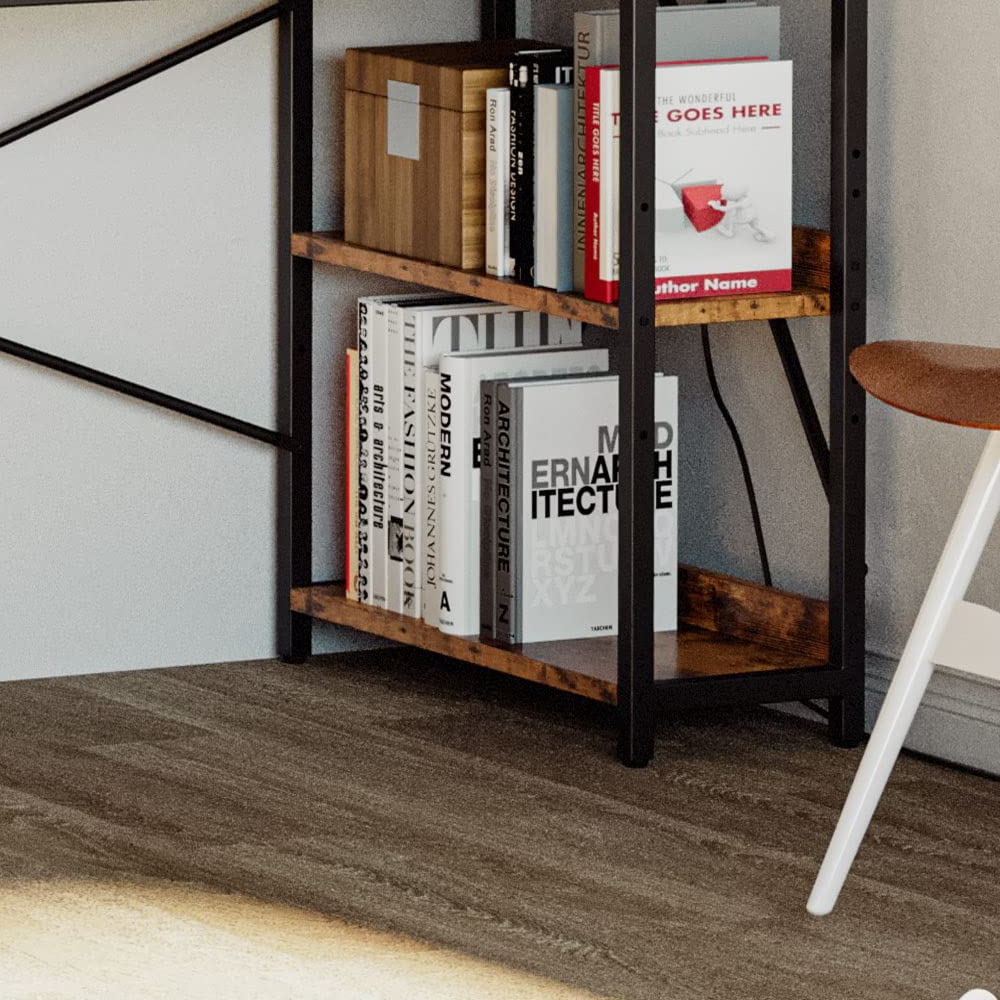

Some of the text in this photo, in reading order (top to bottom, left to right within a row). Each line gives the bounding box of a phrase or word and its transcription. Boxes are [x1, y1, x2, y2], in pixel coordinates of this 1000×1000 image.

[489, 98, 497, 122] Ron
[666, 106, 724, 123] GOES
[731, 103, 782, 118] HERE
[678, 91, 737, 105] WONDERFUL
[489, 124, 497, 152] Arad
[592, 102, 600, 182] TITLE GOES HERE
[654, 278, 758, 295] uthor Name
[373, 384, 386, 414] arts
[483, 393, 492, 425] Ron
[440, 373, 452, 478] MODERN
[598, 421, 674, 454] MD
[404, 385, 416, 513] FASHION
[483, 430, 492, 468] Arad
[373, 438, 388, 529] architecture
[498, 400, 511, 574] ARCHITECTURE
[531, 449, 673, 489] ERNAH
[531, 480, 673, 520] ITECTE
[426, 485, 437, 590] JOHANNES
[403, 522, 415, 609] BOOK
[440, 590, 451, 612] A
